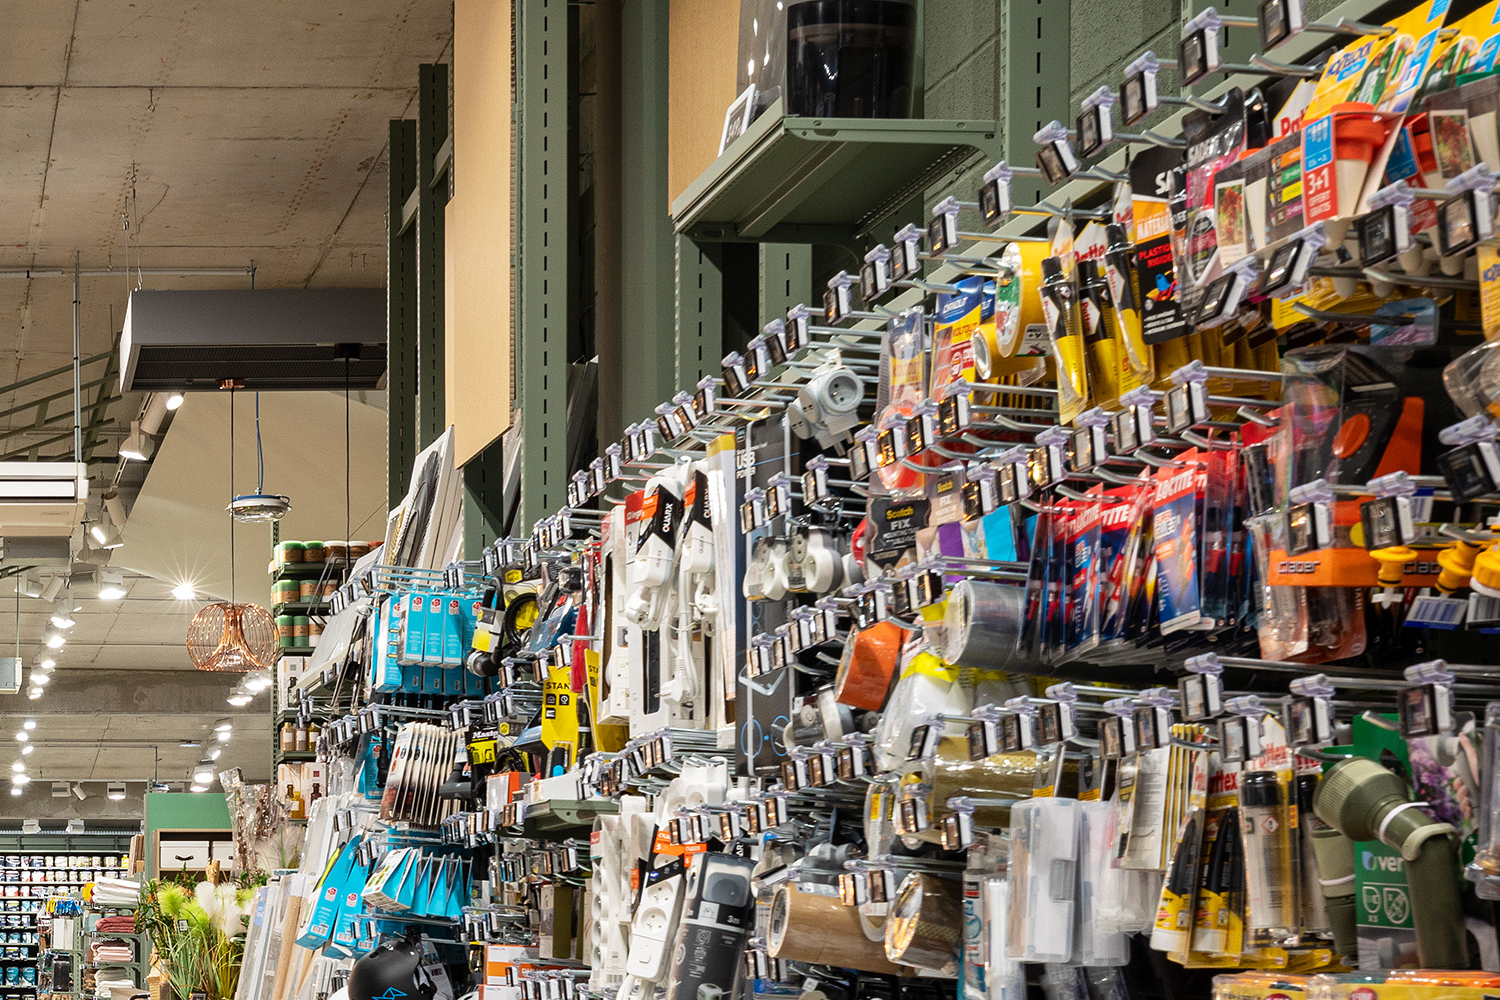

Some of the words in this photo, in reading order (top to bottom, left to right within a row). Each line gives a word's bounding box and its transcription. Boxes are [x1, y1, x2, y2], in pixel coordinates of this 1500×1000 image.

[1156, 469, 1194, 501] LOCTITE
[663, 503, 673, 532] QUARX
[886, 506, 914, 520] Scotch
[891, 518, 911, 531] FIX
